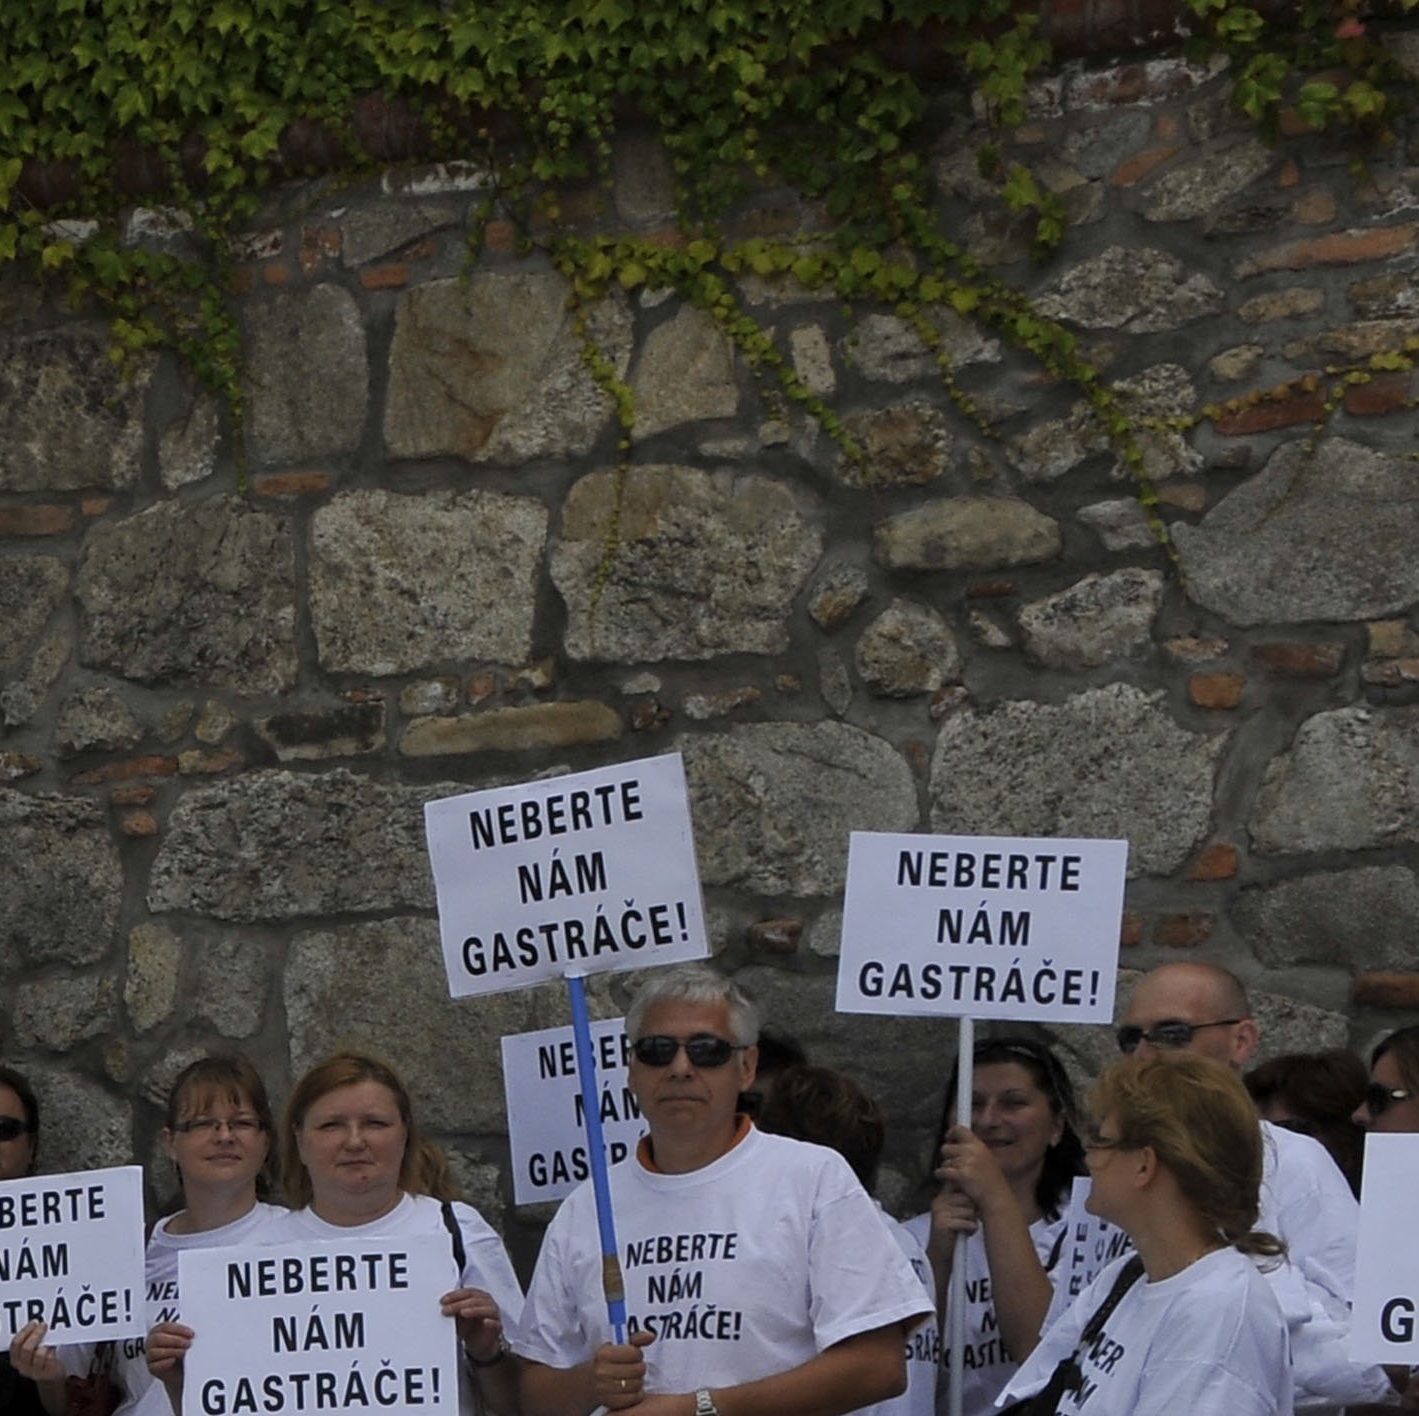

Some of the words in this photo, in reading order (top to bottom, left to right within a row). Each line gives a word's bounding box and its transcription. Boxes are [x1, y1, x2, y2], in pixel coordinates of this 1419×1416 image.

[469, 780, 643, 850] NEBERTE
[518, 848, 607, 903] NÁM
[897, 851, 1081, 891] NEBERTE
[462, 899, 689, 976] GASTRÁČE!
[937, 900, 1030, 946] NÁM
[858, 957, 1099, 1006] GASTRÁČE!
[626, 1233, 738, 1269] NEBERTE
[227, 1253, 409, 1298] NEBERTE
[648, 1267, 702, 1303] NÁM
[273, 1305, 365, 1353] NÁM
[627, 1304, 742, 1341] ASTRÁČE!
[201, 1360, 440, 1416] GASTRÁČE!
